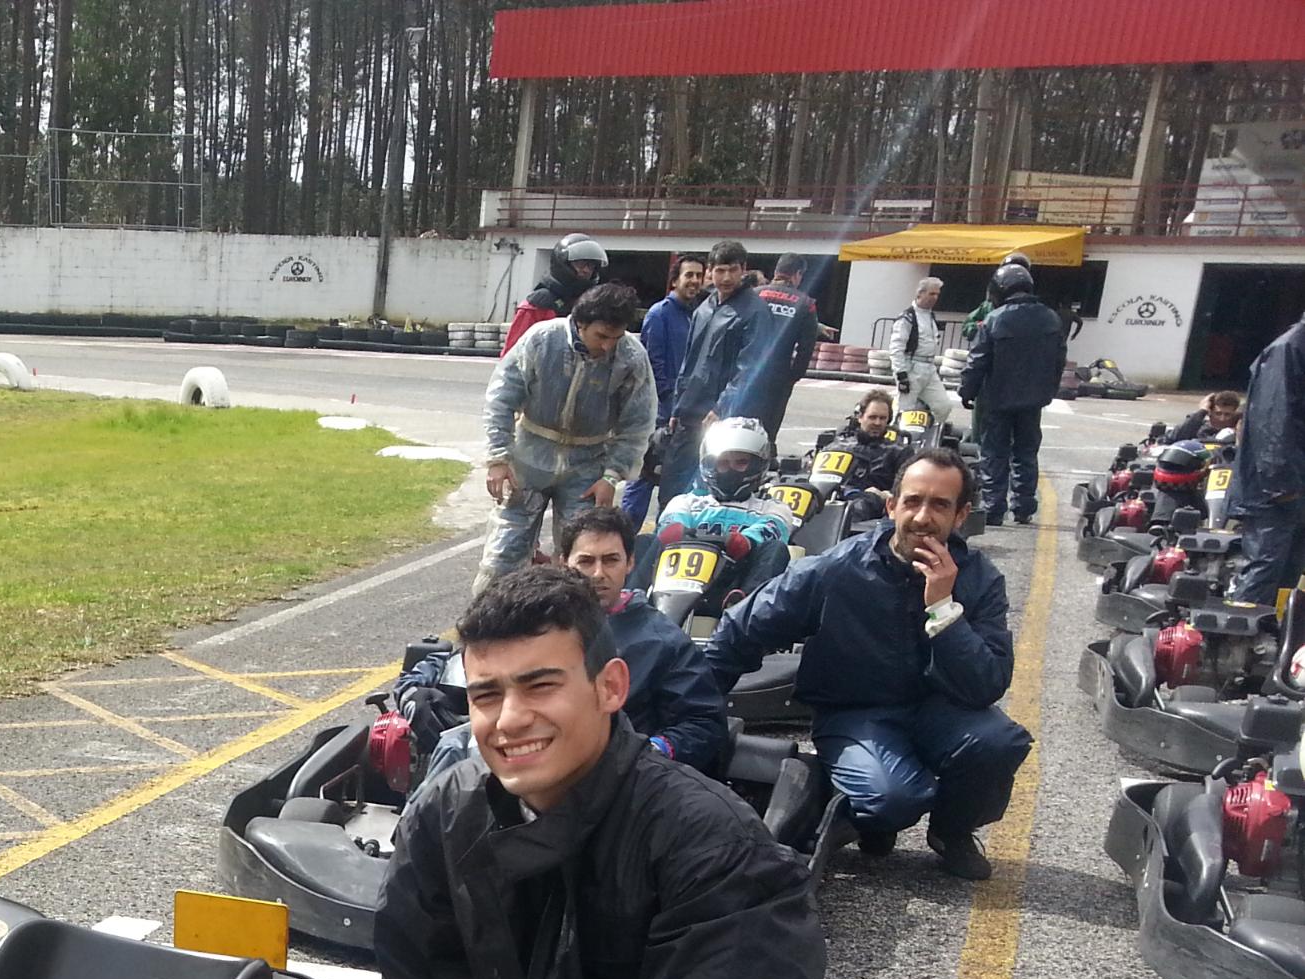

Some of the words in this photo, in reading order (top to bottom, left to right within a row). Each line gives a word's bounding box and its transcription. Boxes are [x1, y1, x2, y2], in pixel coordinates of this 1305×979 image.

[768, 302, 796, 315] arco
[910, 411, 927, 425] 29
[819, 453, 846, 470] 21
[666, 551, 705, 577] 99
